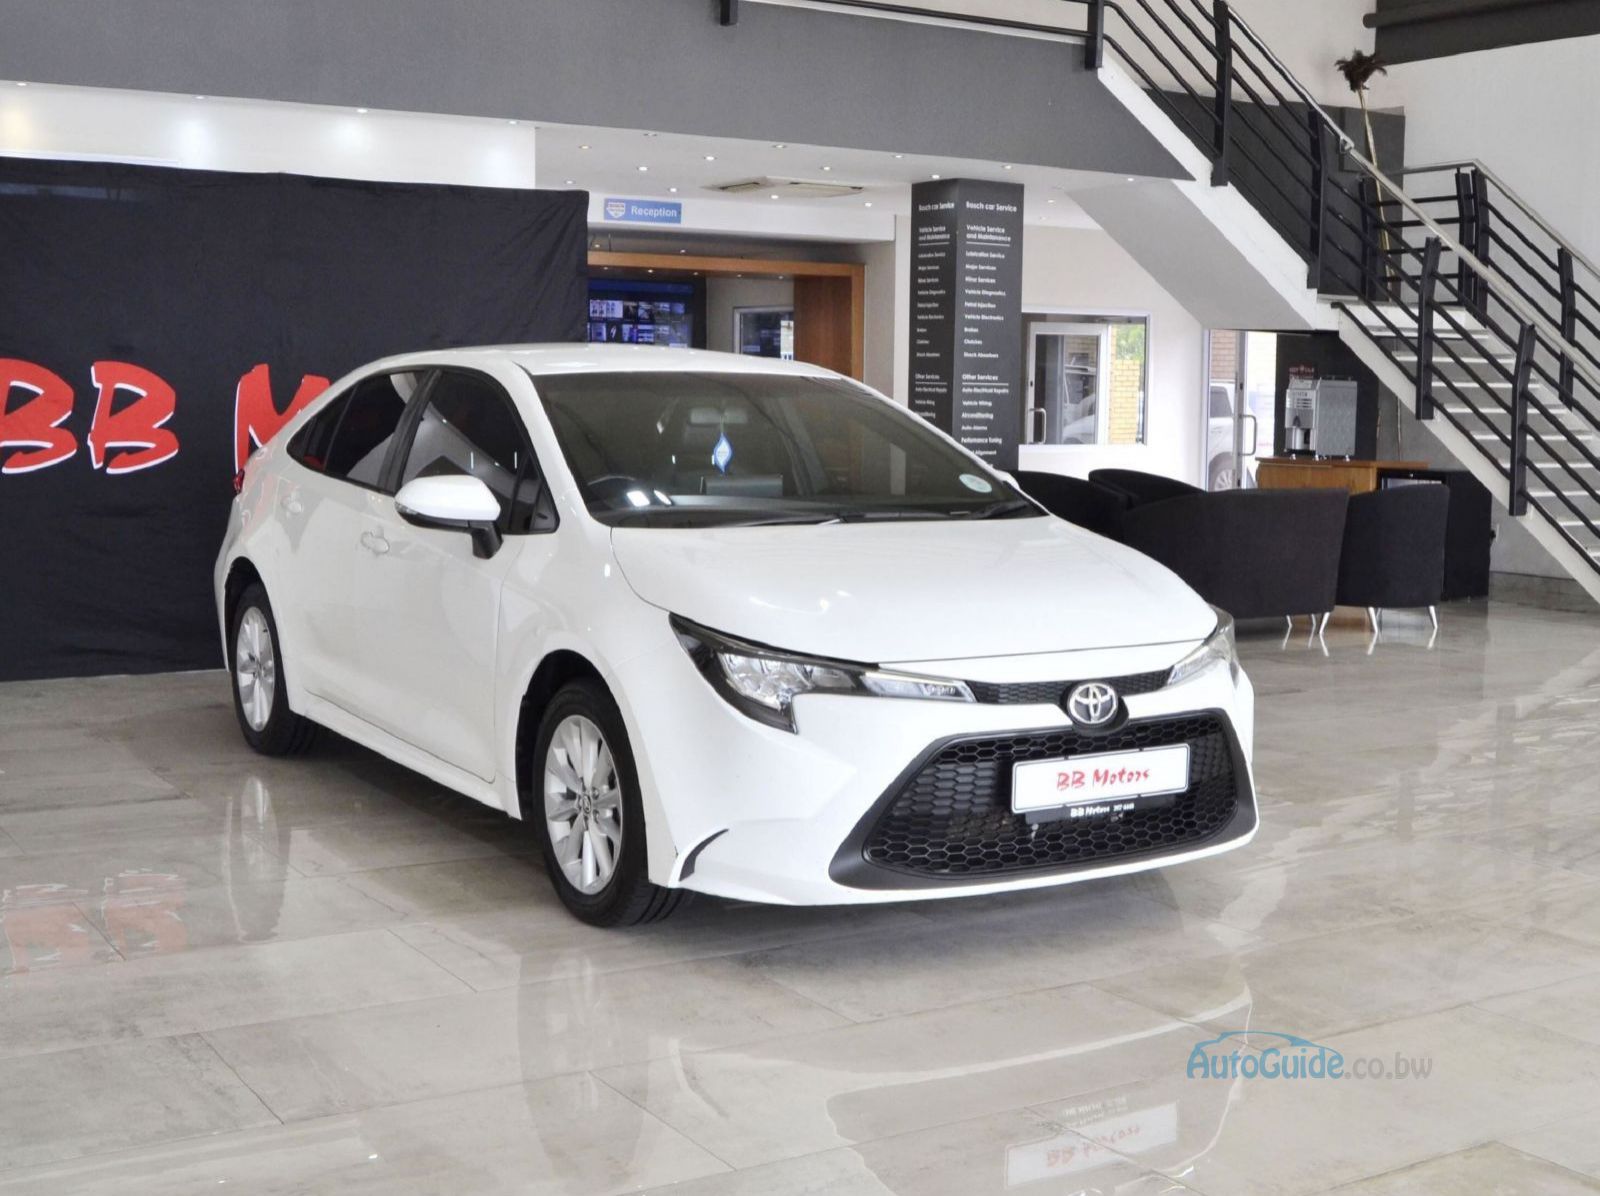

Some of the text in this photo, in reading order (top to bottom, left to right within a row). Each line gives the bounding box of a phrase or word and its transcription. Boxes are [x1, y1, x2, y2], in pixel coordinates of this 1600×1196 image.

[631, 205, 677, 218] Reception
[966, 201, 984, 210] Bosch
[996, 203, 1017, 212] Service
[966, 224, 986, 232] Vehicle
[0, 358, 180, 474] BB
[1056, 767, 1150, 792] BB Motors
